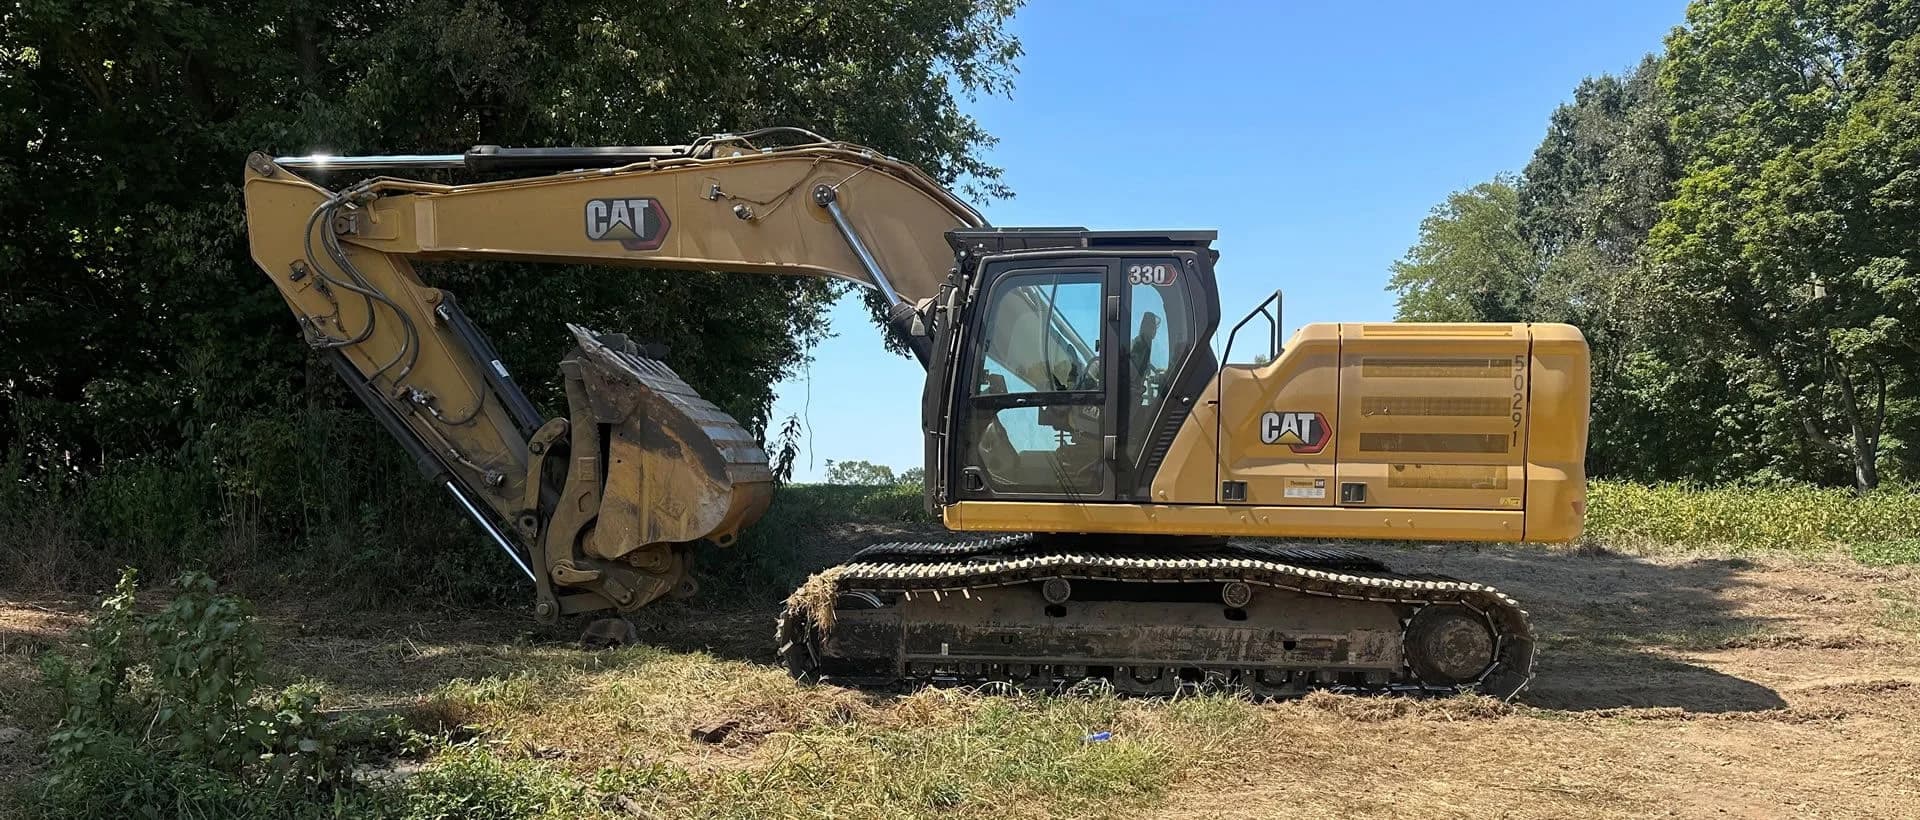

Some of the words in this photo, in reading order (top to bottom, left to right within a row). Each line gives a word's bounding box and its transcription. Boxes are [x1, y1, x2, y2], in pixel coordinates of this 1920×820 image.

[586, 199, 649, 240] CAT
[1129, 265, 1166, 284] 330
[1512, 354, 1525, 448] 50291
[1261, 412, 1315, 444] CAT
